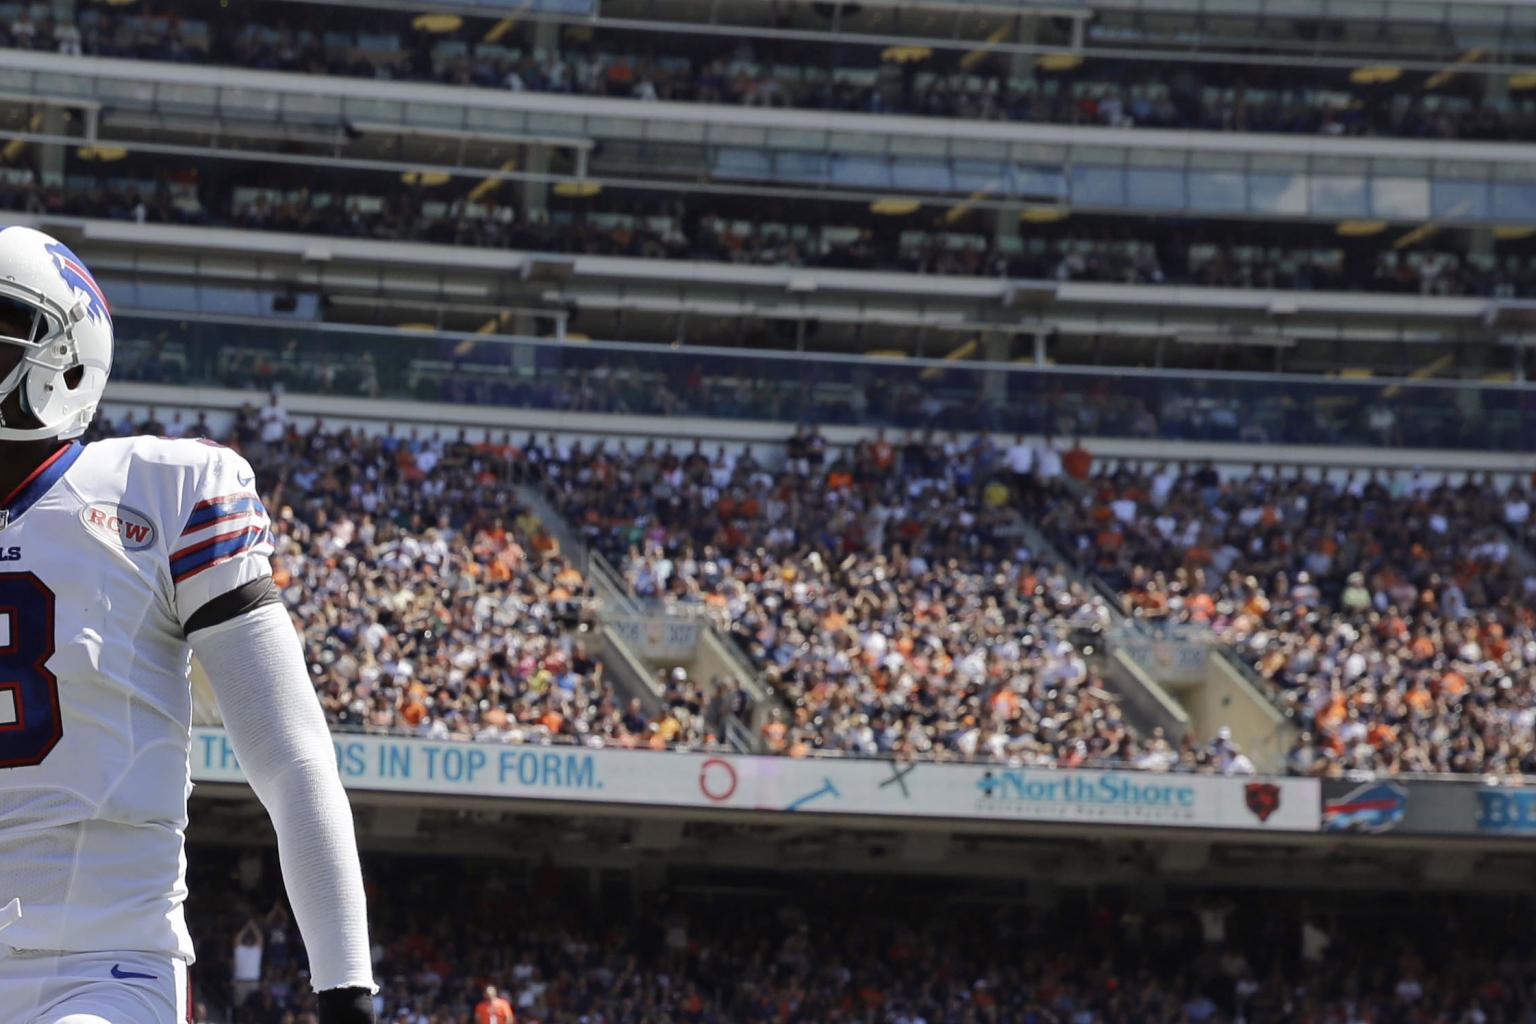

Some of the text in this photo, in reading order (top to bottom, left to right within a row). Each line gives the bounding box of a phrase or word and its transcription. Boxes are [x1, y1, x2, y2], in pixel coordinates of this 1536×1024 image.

[88, 507, 151, 543] RCW
[379, 744, 411, 778] IN
[422, 747, 486, 783] TOP
[498, 751, 604, 789] FORM.
[1002, 771, 1195, 806] NorthShore
